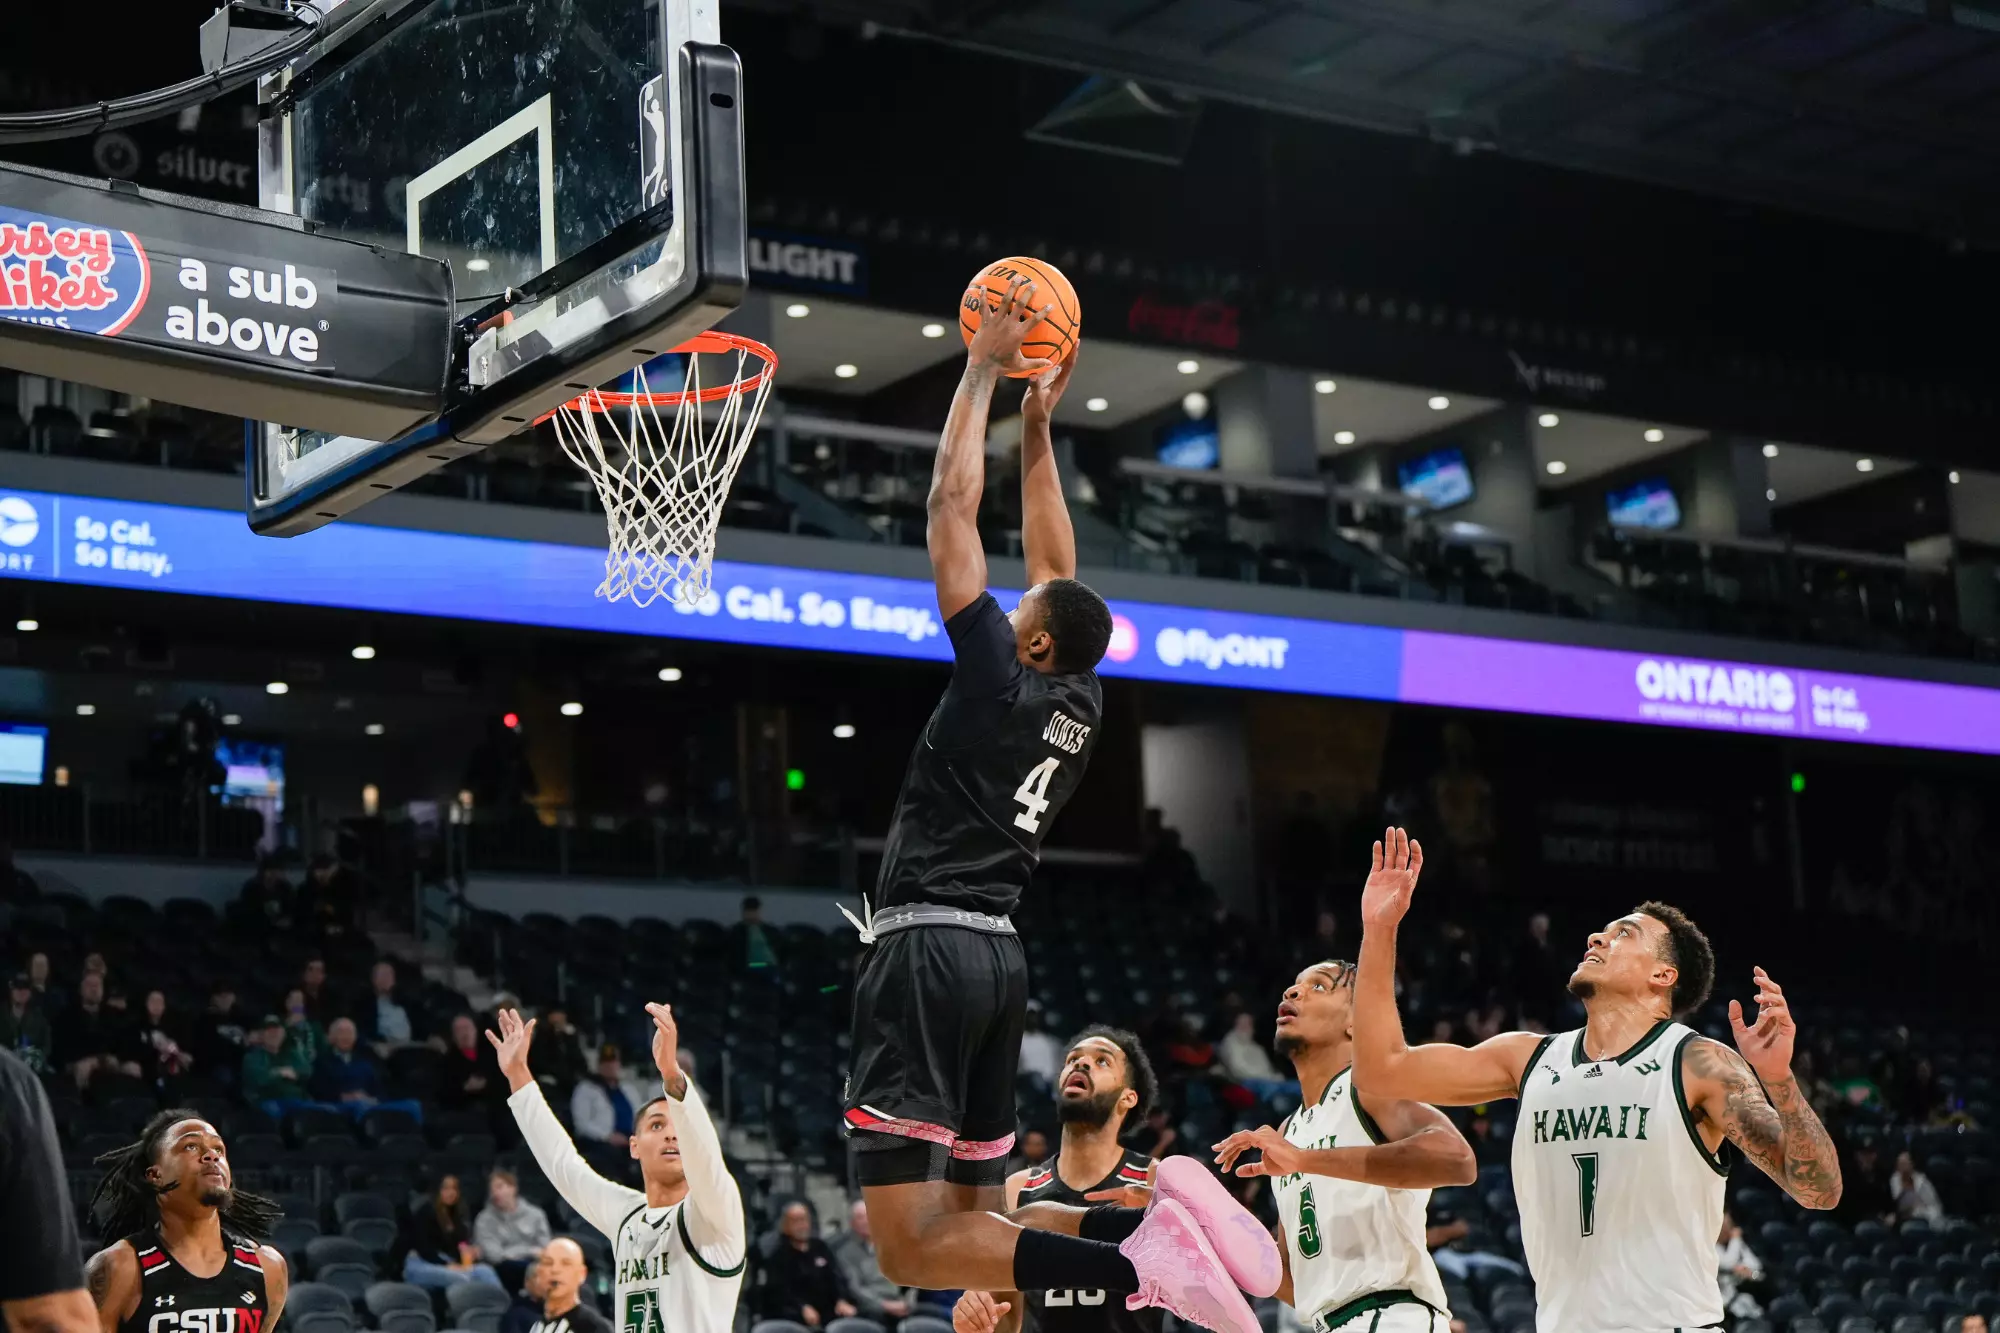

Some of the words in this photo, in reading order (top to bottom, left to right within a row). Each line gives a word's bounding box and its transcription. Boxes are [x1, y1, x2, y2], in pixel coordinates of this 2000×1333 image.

[158, 145, 251, 189] silver
[0, 259, 117, 310] ike's
[179, 258, 207, 292] a
[228, 264, 318, 309] sub
[748, 237, 859, 285] LIGHT
[74, 515, 108, 542] So
[74, 541, 108, 567] So
[725, 584, 795, 624] Cal.
[798, 591, 846, 629] So
[849, 595, 940, 642] Easy.
[1635, 659, 1796, 713] ONTARIO
[1042, 710, 1091, 754] JONES
[1013, 756, 1060, 834] 4
[1298, 1181, 1322, 1260] 5
[1571, 1152, 1599, 1238] 1
